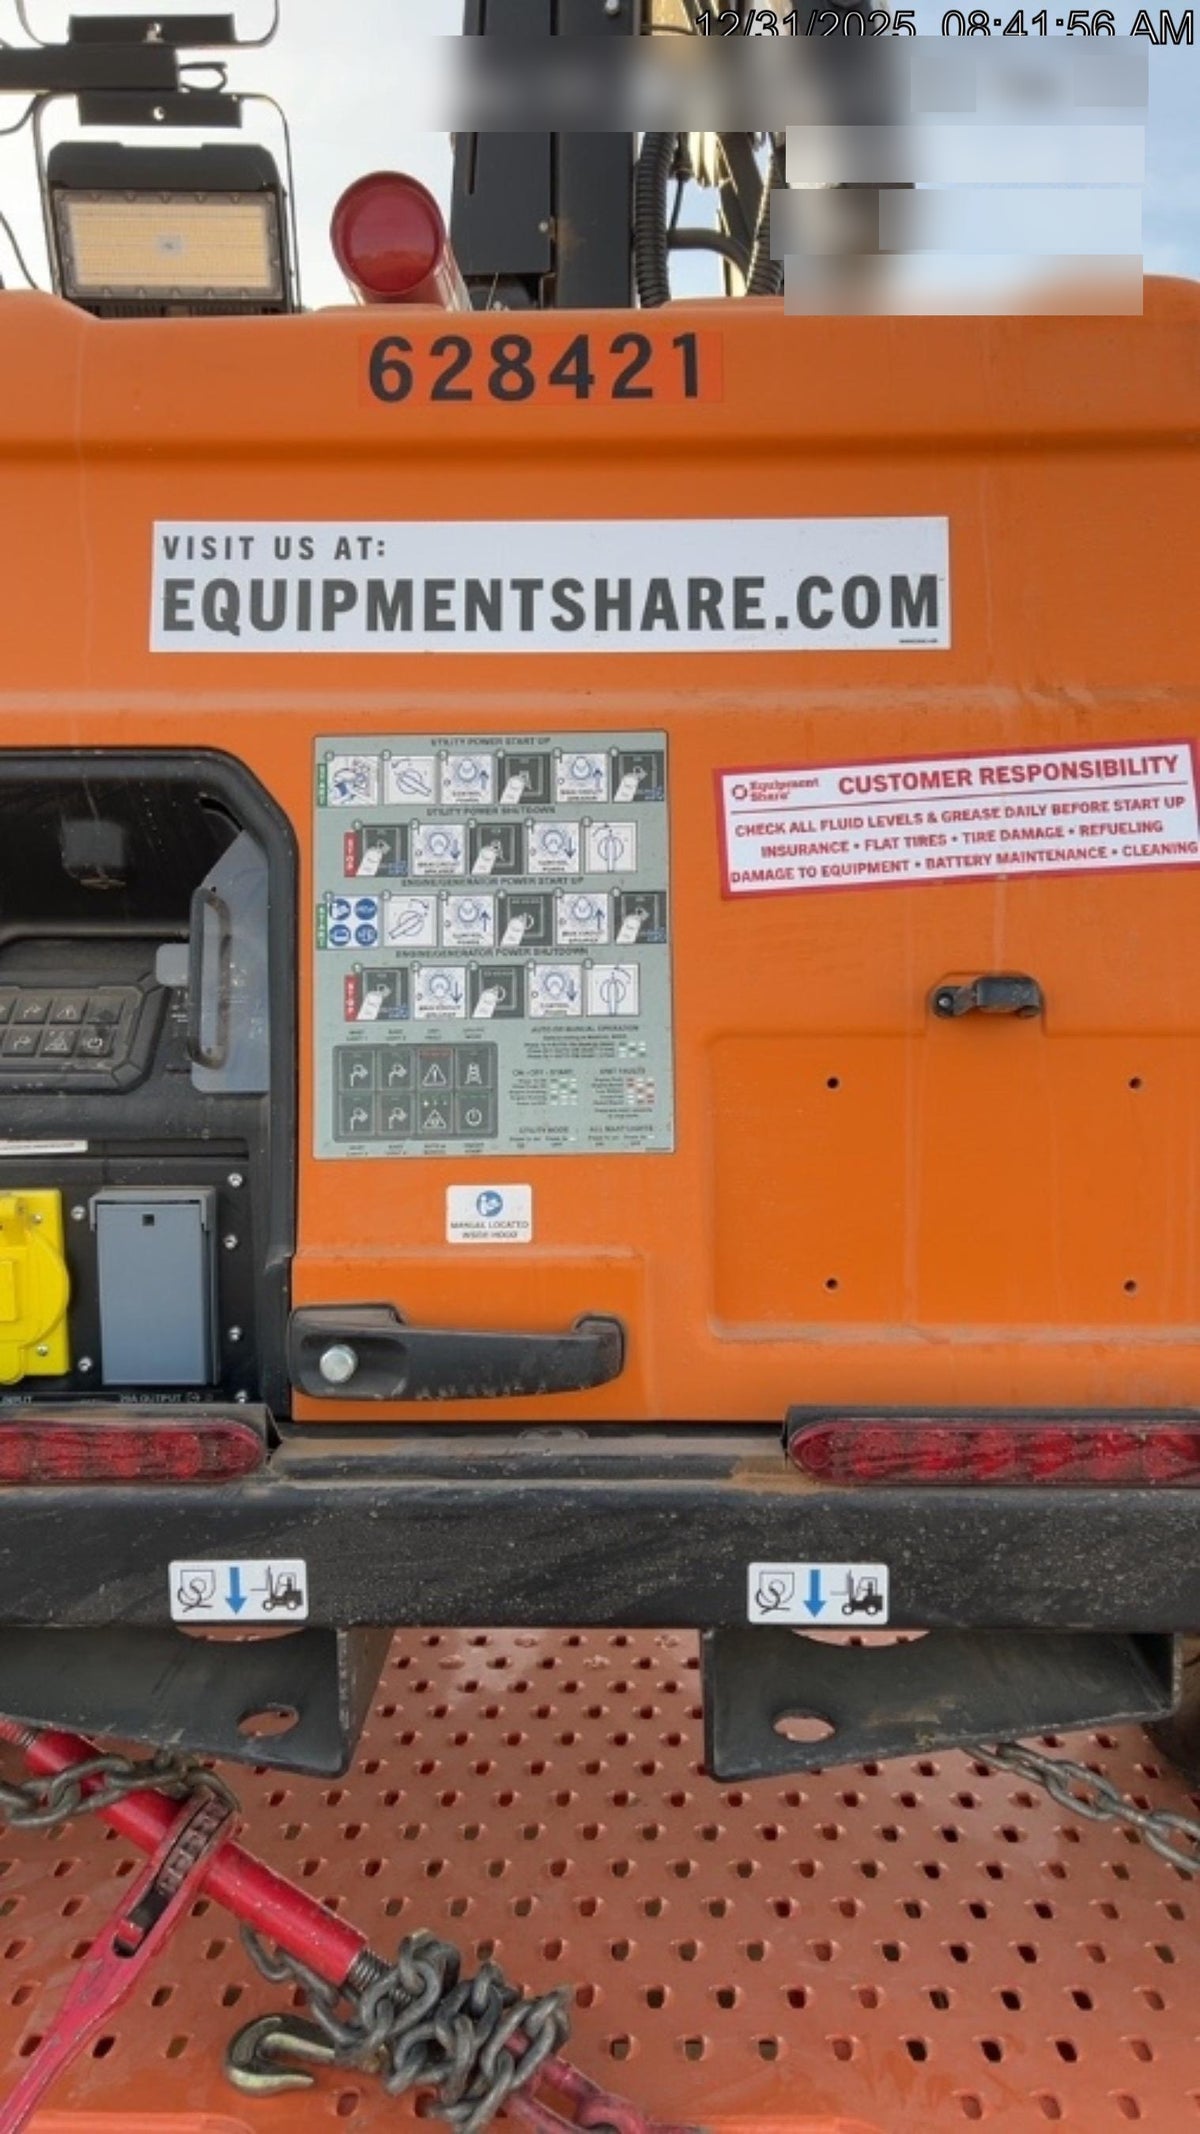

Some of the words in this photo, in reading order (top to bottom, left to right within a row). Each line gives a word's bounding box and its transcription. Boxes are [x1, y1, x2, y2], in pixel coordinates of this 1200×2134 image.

[368, 332, 698, 403] 628421
[162, 535, 256, 561] VISIT
[274, 535, 315, 561] US
[333, 535, 386, 561] AT:
[162, 574, 938, 636] EQUIPMENTSHARE.COM
[749, 777, 819, 792] Equipment
[838, 769, 973, 795] CUSTOMER
[979, 755, 1179, 785] RESPONSIBILITY
[735, 824, 786, 838] CHECK
[789, 820, 816, 833] ALL
[820, 817, 864, 831] FLUID
[867, 813, 923, 829] LEVELS
[927, 811, 938, 824] &
[941, 807, 1001, 822] GREASE
[1004, 803, 1047, 819] DAILY
[1052, 799, 1111, 816] BEFORE
[1114, 796, 1160, 812] START
[1164, 796, 1186, 809] UP
[761, 840, 850, 859] INSURANCE
[865, 837, 900, 851] FLAT
[904, 834, 947, 849] TIRES
[962, 830, 996, 844] TIRE
[1000, 825, 1065, 842] DAMAGE
[1078, 820, 1164, 837] REFUELING
[731, 867, 795, 884] DAMAGE
[800, 866, 818, 879] TO
[822, 859, 910, 878] EQUIPMENT
[925, 853, 992, 871] BATTERY
[996, 846, 1108, 865] MAINTENANCE
[1121, 841, 1198, 858] CLEANING
[488, 1220, 529, 1229] LOCATED
